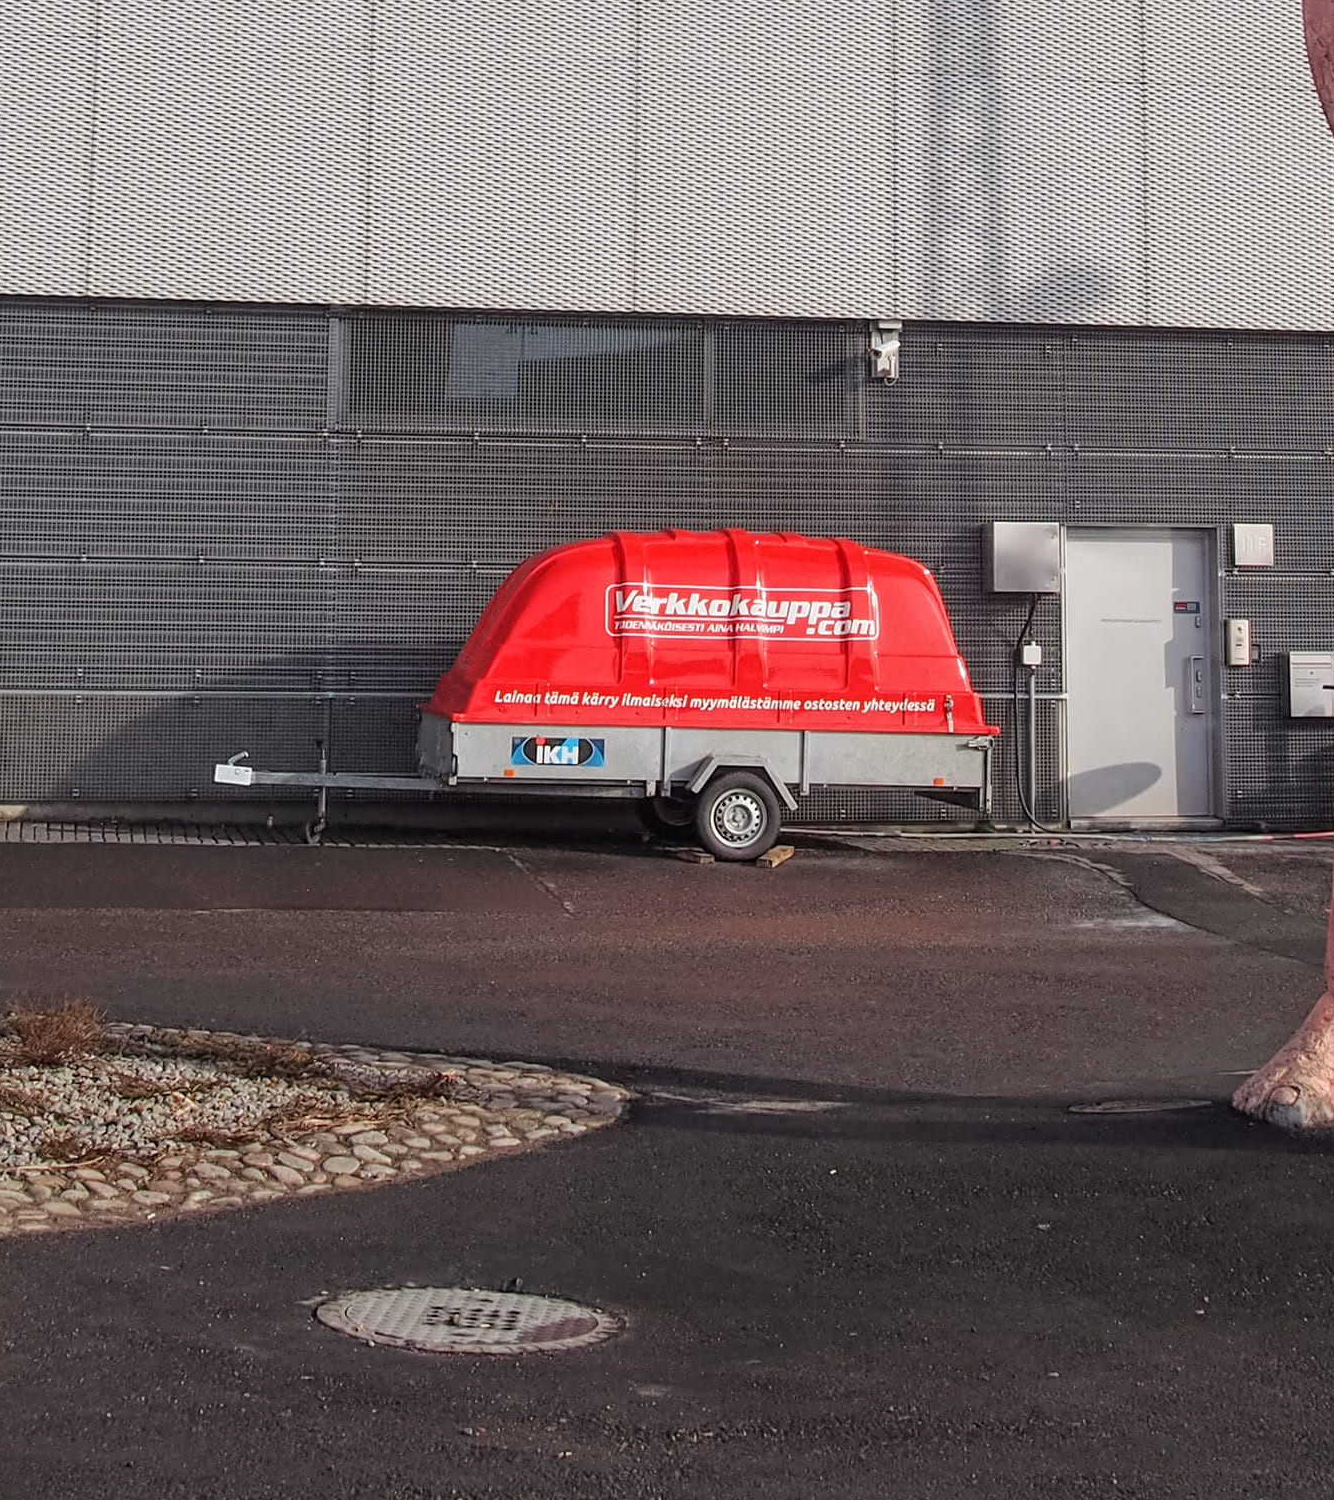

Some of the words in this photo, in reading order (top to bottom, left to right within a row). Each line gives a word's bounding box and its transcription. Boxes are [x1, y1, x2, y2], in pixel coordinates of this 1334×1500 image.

[615, 590, 850, 624] Verkkokauppa
[707, 621, 734, 633] AINA
[806, 618, 876, 637] .com
[494, 690, 541, 704] Lainaa
[544, 691, 579, 706] tämä
[581, 691, 618, 708] kärry
[621, 692, 687, 708] ilmaiseksi
[689, 695, 801, 712] myymälästämme
[804, 698, 860, 711] ostosten
[862, 698, 936, 714] yhteydessä
